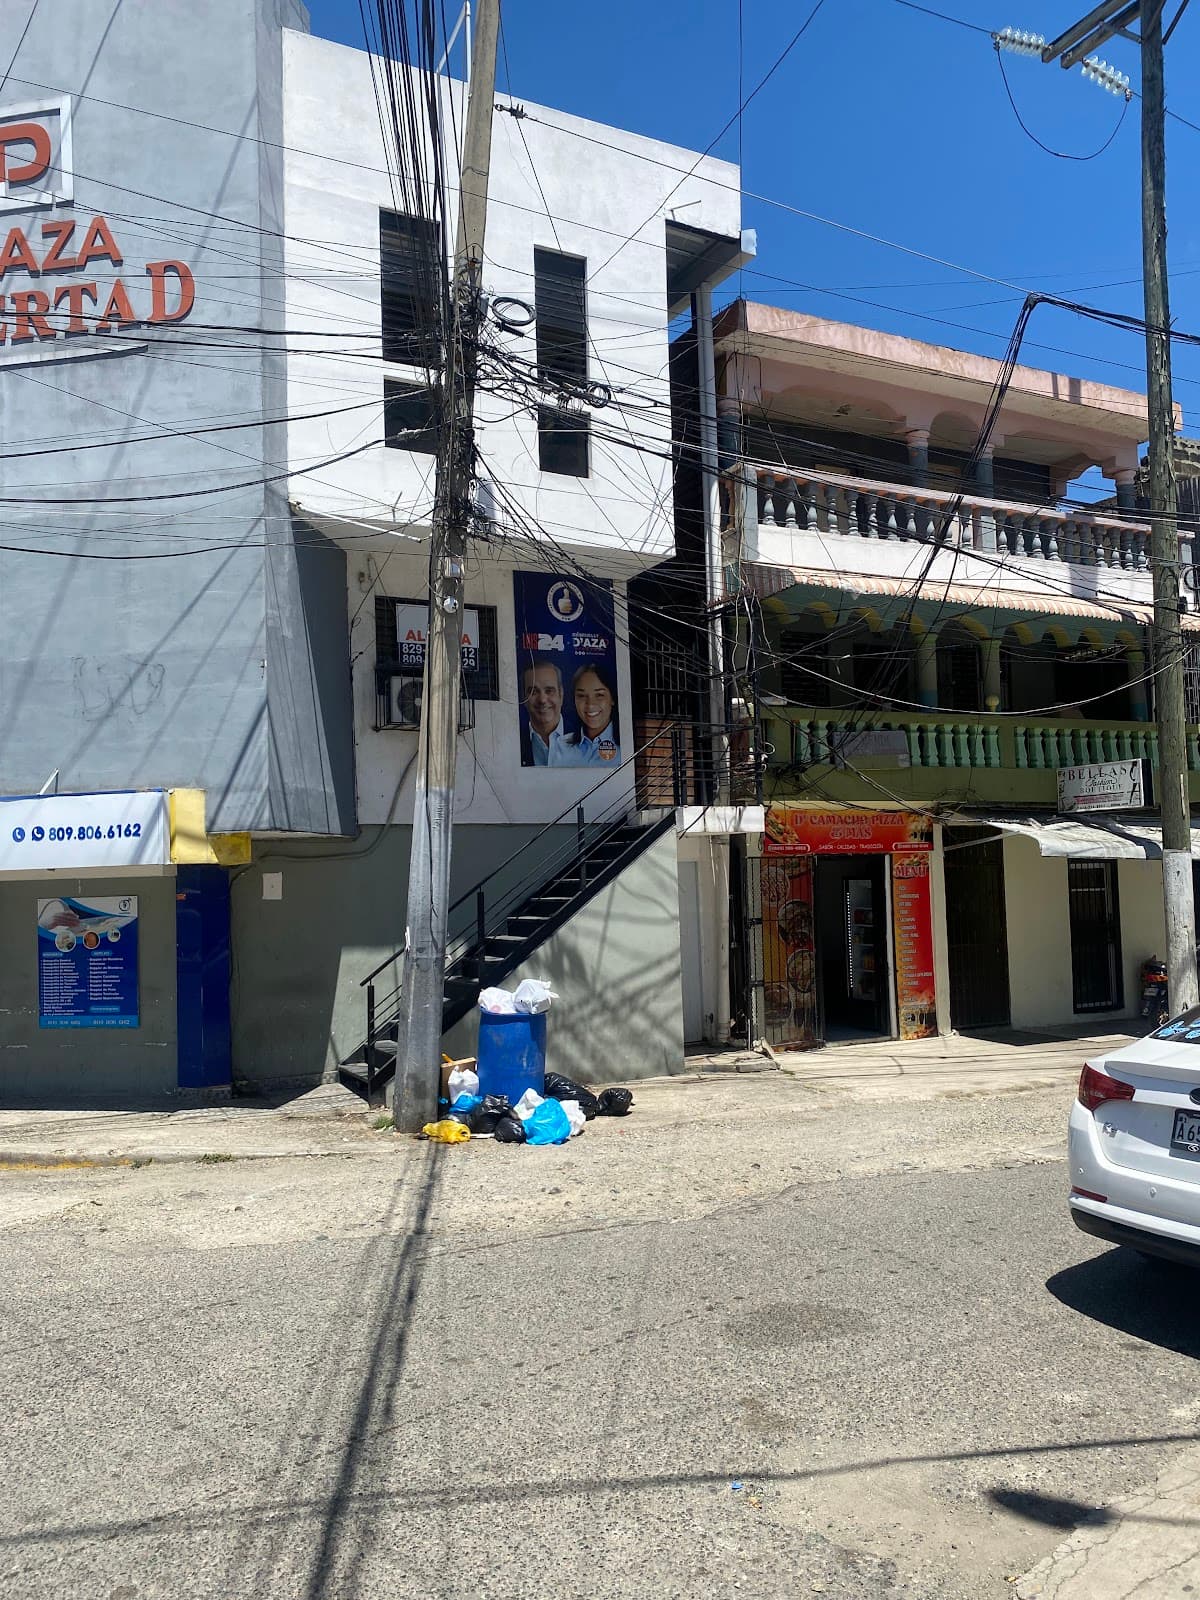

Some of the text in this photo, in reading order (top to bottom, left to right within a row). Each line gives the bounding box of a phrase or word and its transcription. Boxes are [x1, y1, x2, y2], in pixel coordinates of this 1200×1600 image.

[0, 260, 195, 341] RTAD
[537, 633, 564, 651] 24
[871, 814, 905, 826] PIZZA
[49, 823, 141, 841] 809.806.6162
